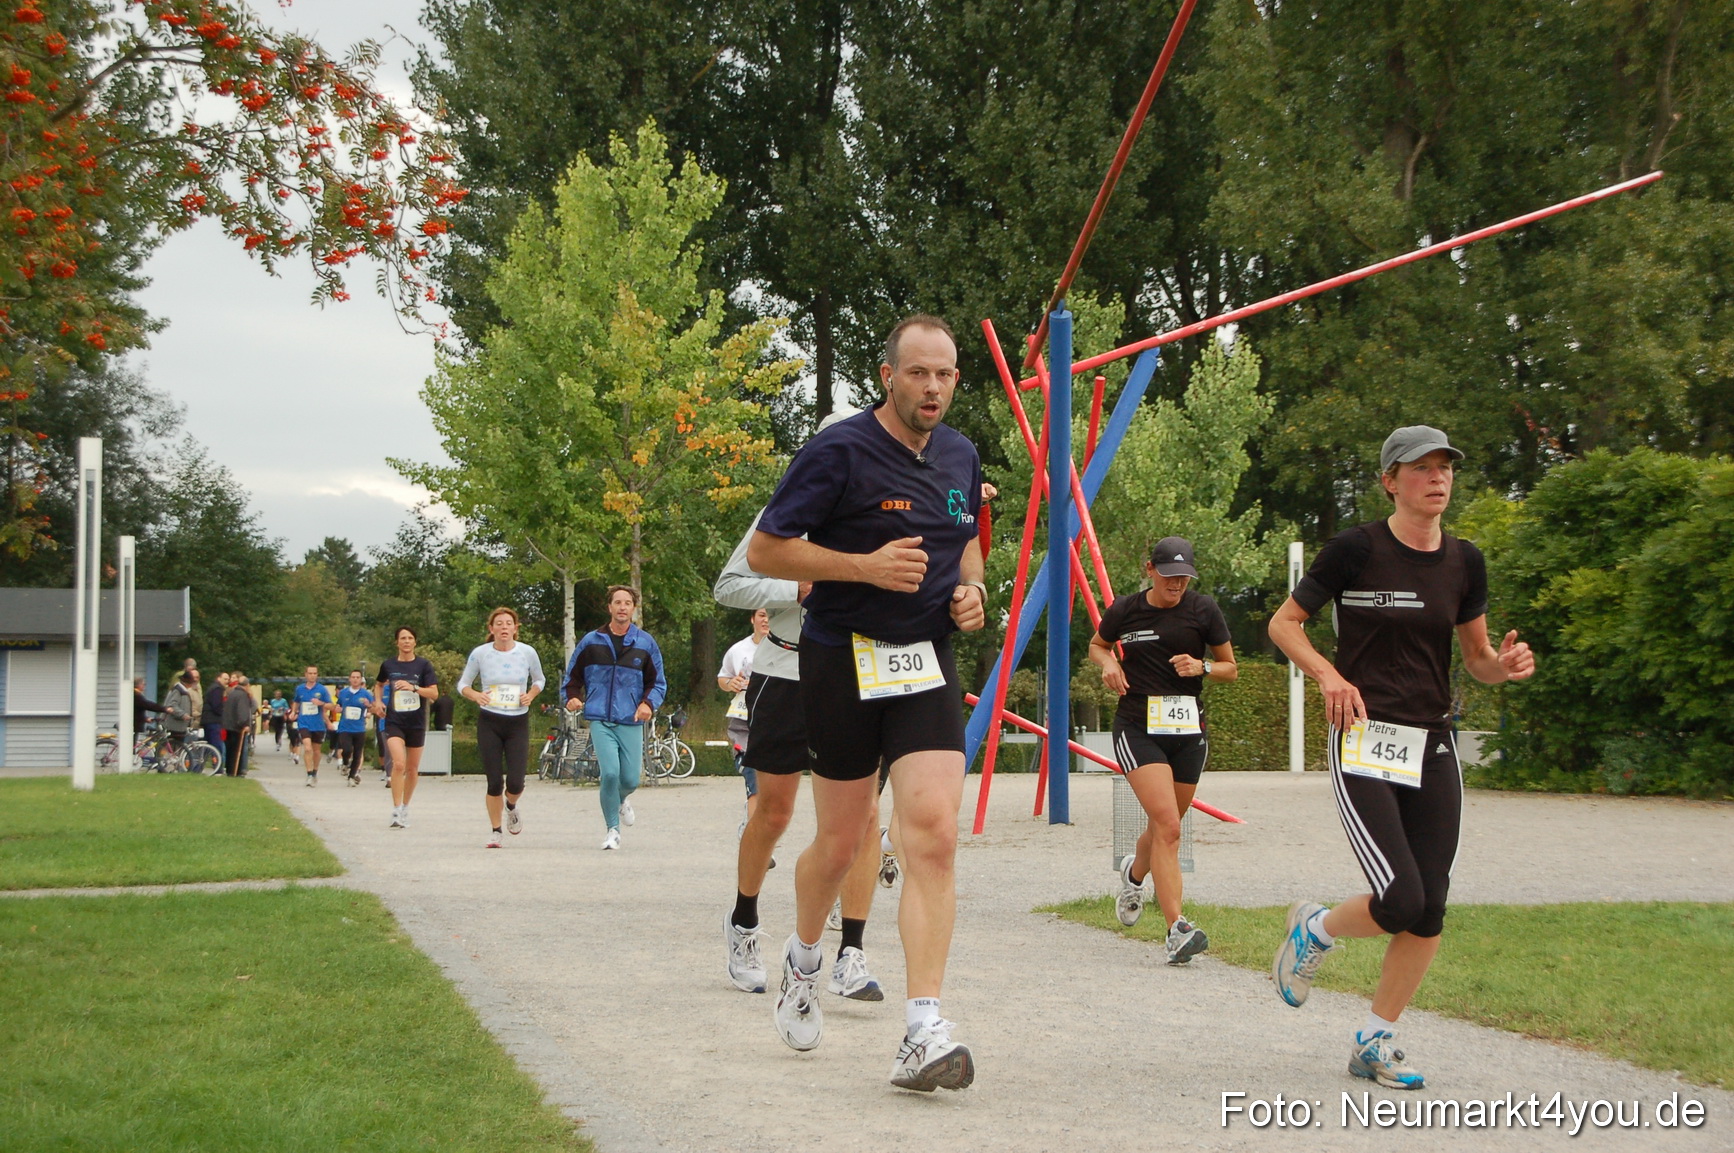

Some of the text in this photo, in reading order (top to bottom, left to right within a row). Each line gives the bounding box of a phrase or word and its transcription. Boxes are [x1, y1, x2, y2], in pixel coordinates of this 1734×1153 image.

[881, 500, 912, 510] OBI
[859, 657, 866, 667] C
[888, 653, 923, 672] 530
[403, 697, 417, 705] 993
[500, 694, 515, 702] 752
[1168, 708, 1190, 720] 451
[1368, 721, 1397, 736] Petra
[1345, 734, 1352, 744] C
[1371, 741, 1408, 764] 454
